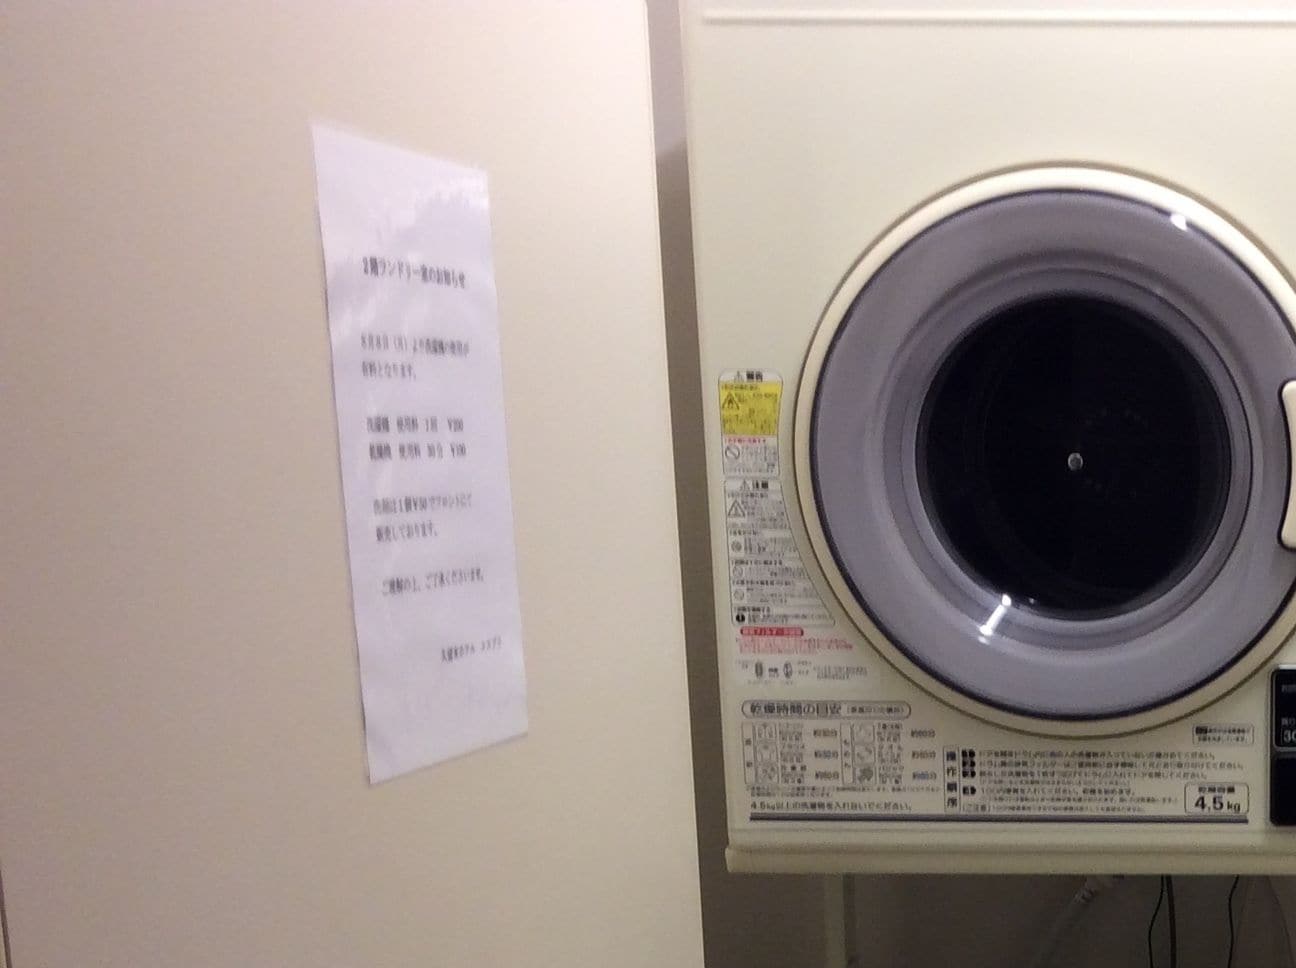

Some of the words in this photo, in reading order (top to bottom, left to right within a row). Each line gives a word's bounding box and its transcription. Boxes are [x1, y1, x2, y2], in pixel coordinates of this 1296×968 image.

[749, 702, 842, 717] 乾燥時間の目安
